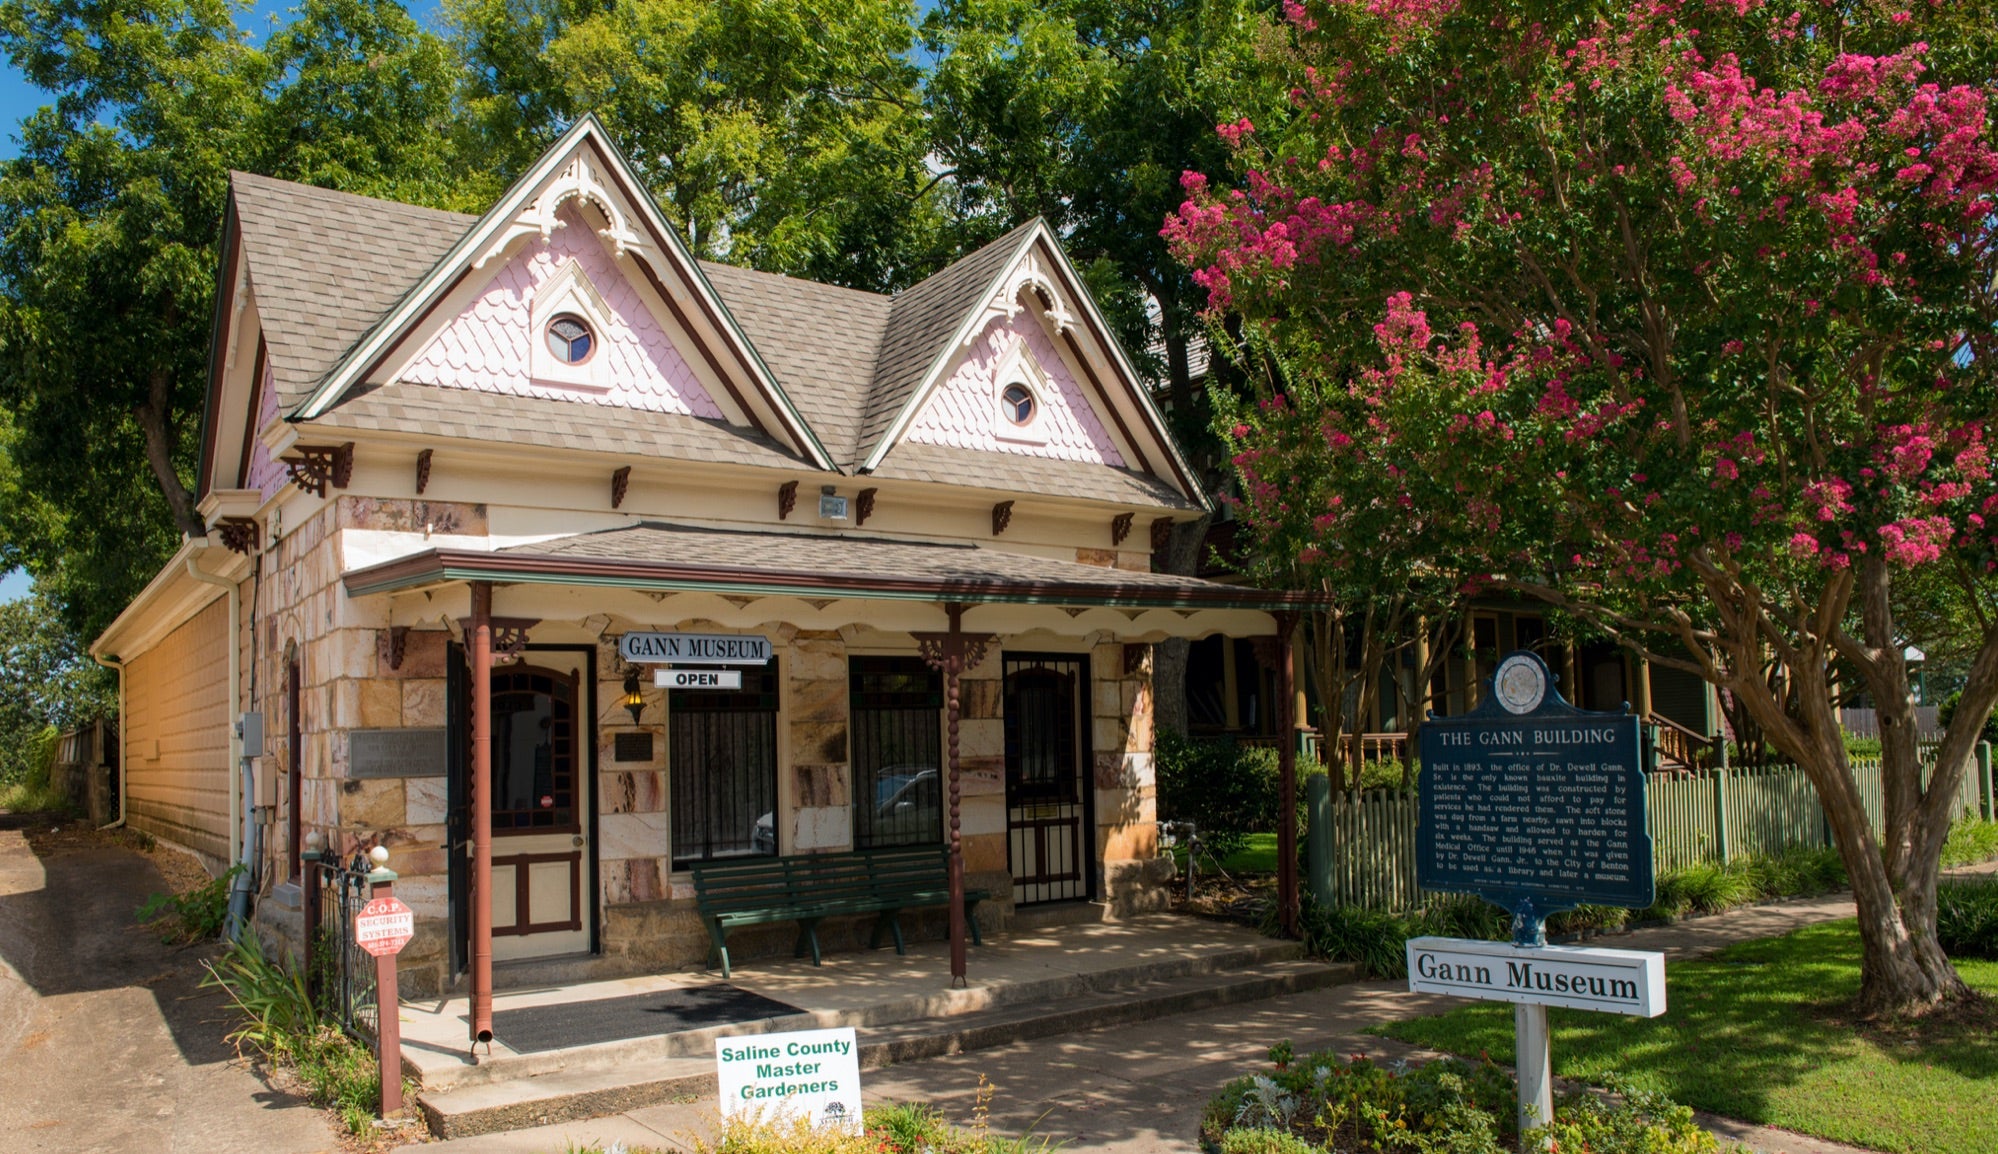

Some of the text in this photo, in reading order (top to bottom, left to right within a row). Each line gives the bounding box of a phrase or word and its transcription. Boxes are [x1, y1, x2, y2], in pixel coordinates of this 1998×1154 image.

[629, 637, 764, 658] GANN MUSEUM
[676, 674, 718, 685] OPEN
[1440, 729, 1615, 745] THE GANN BUILDING
[1567, 762, 1595, 770] Dewell
[1575, 774, 1608, 782] building
[1498, 784, 1528, 792] building
[1614, 785, 1625, 793] by
[1464, 802, 1473, 810] he
[1494, 804, 1529, 812] rendered
[1565, 805, 1580, 813] The
[1585, 806, 1599, 814] soft
[1601, 817, 1626, 825] blocks
[1578, 827, 1606, 835] harden
[1502, 835, 1531, 845] building
[1537, 837, 1563, 845] served
[1606, 839, 1627, 847] Gann
[1467, 843, 1489, 851] Office
[1605, 851, 1628, 860] given
[1462, 853, 1485, 861] Dewell
[1564, 859, 1580, 868] City
[1600, 861, 1628, 869] Benton
[1508, 866, 1534, 876] library
[1559, 869, 1577, 877] later
[368, 903, 402, 914] C.O.P.
[360, 914, 410, 928] SECURITY
[362, 927, 408, 939] SYSTEMS
[1418, 954, 1638, 999] Gann Museum
[722, 1039, 850, 1062] Saline County
[756, 1062, 821, 1078] Master
[741, 1080, 838, 1099] Gardeners
